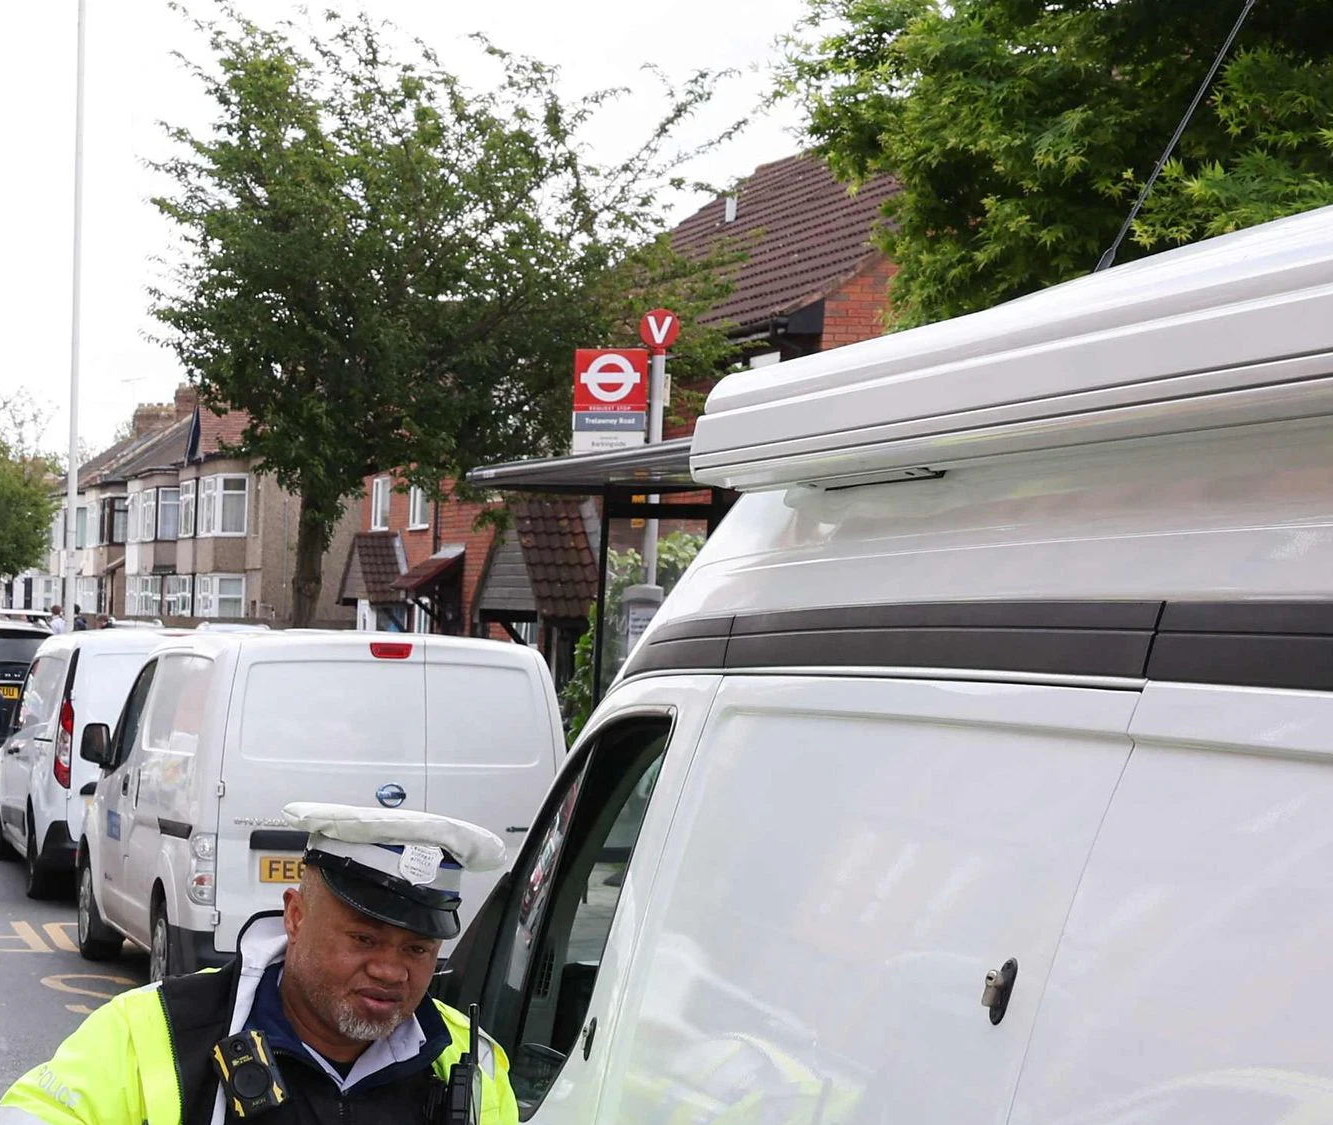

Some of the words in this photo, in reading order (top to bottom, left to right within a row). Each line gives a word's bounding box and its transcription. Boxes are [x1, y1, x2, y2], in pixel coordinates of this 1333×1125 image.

[647, 316, 673, 344] V
[585, 417, 617, 426] Trelawney
[619, 417, 636, 425] Road
